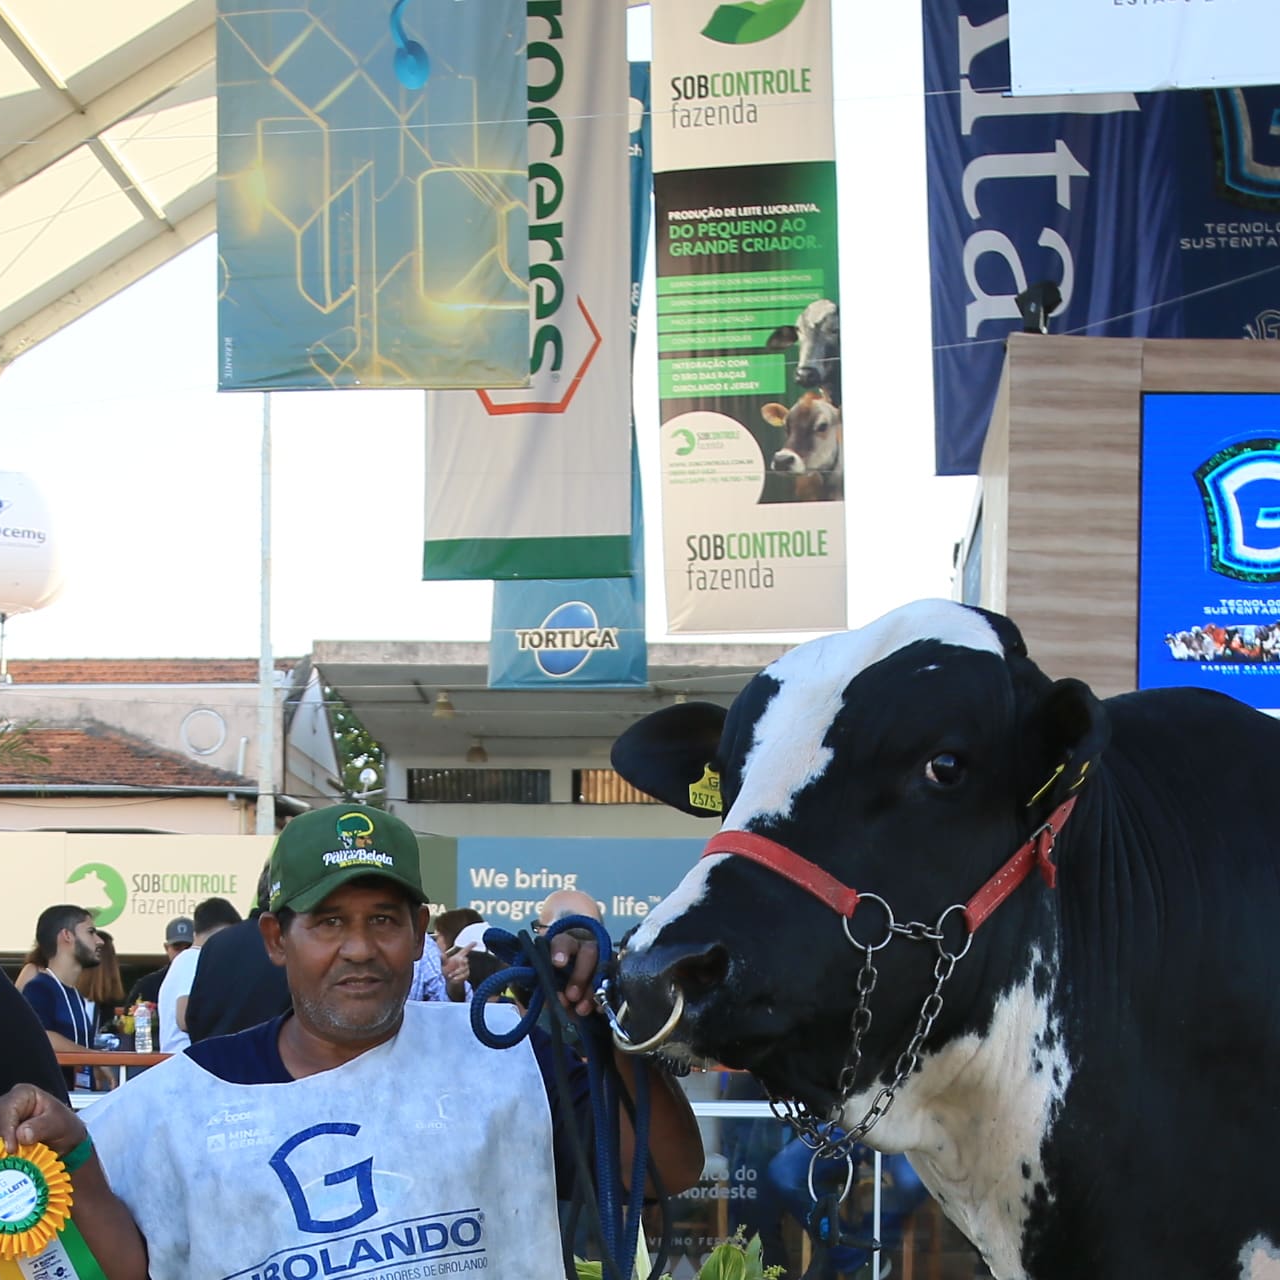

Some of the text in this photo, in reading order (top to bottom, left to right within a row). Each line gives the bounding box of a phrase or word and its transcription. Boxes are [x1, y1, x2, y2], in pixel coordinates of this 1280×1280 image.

[670, 68, 812, 101] SOBCONTROLE
[670, 97, 759, 129] fazenda
[667, 205, 723, 222] PRODUÇÃO
[724, 205, 738, 218] DE
[738, 203, 763, 217] LEITE
[669, 217, 807, 240] DO PEQUENO AO
[669, 238, 739, 257] GRANDE
[686, 530, 828, 562] SOBCONTROLE
[685, 559, 775, 591] fazenda
[516, 629, 617, 650] TORTUGA
[131, 872, 238, 894] SOBCONTROLE
[469, 867, 578, 891] We bring
[130, 893, 196, 916] fazenda
[734, 1164, 758, 1181] do
[423, 1263, 438, 1278] DE
[438, 1256, 489, 1276] GIROLANDO
